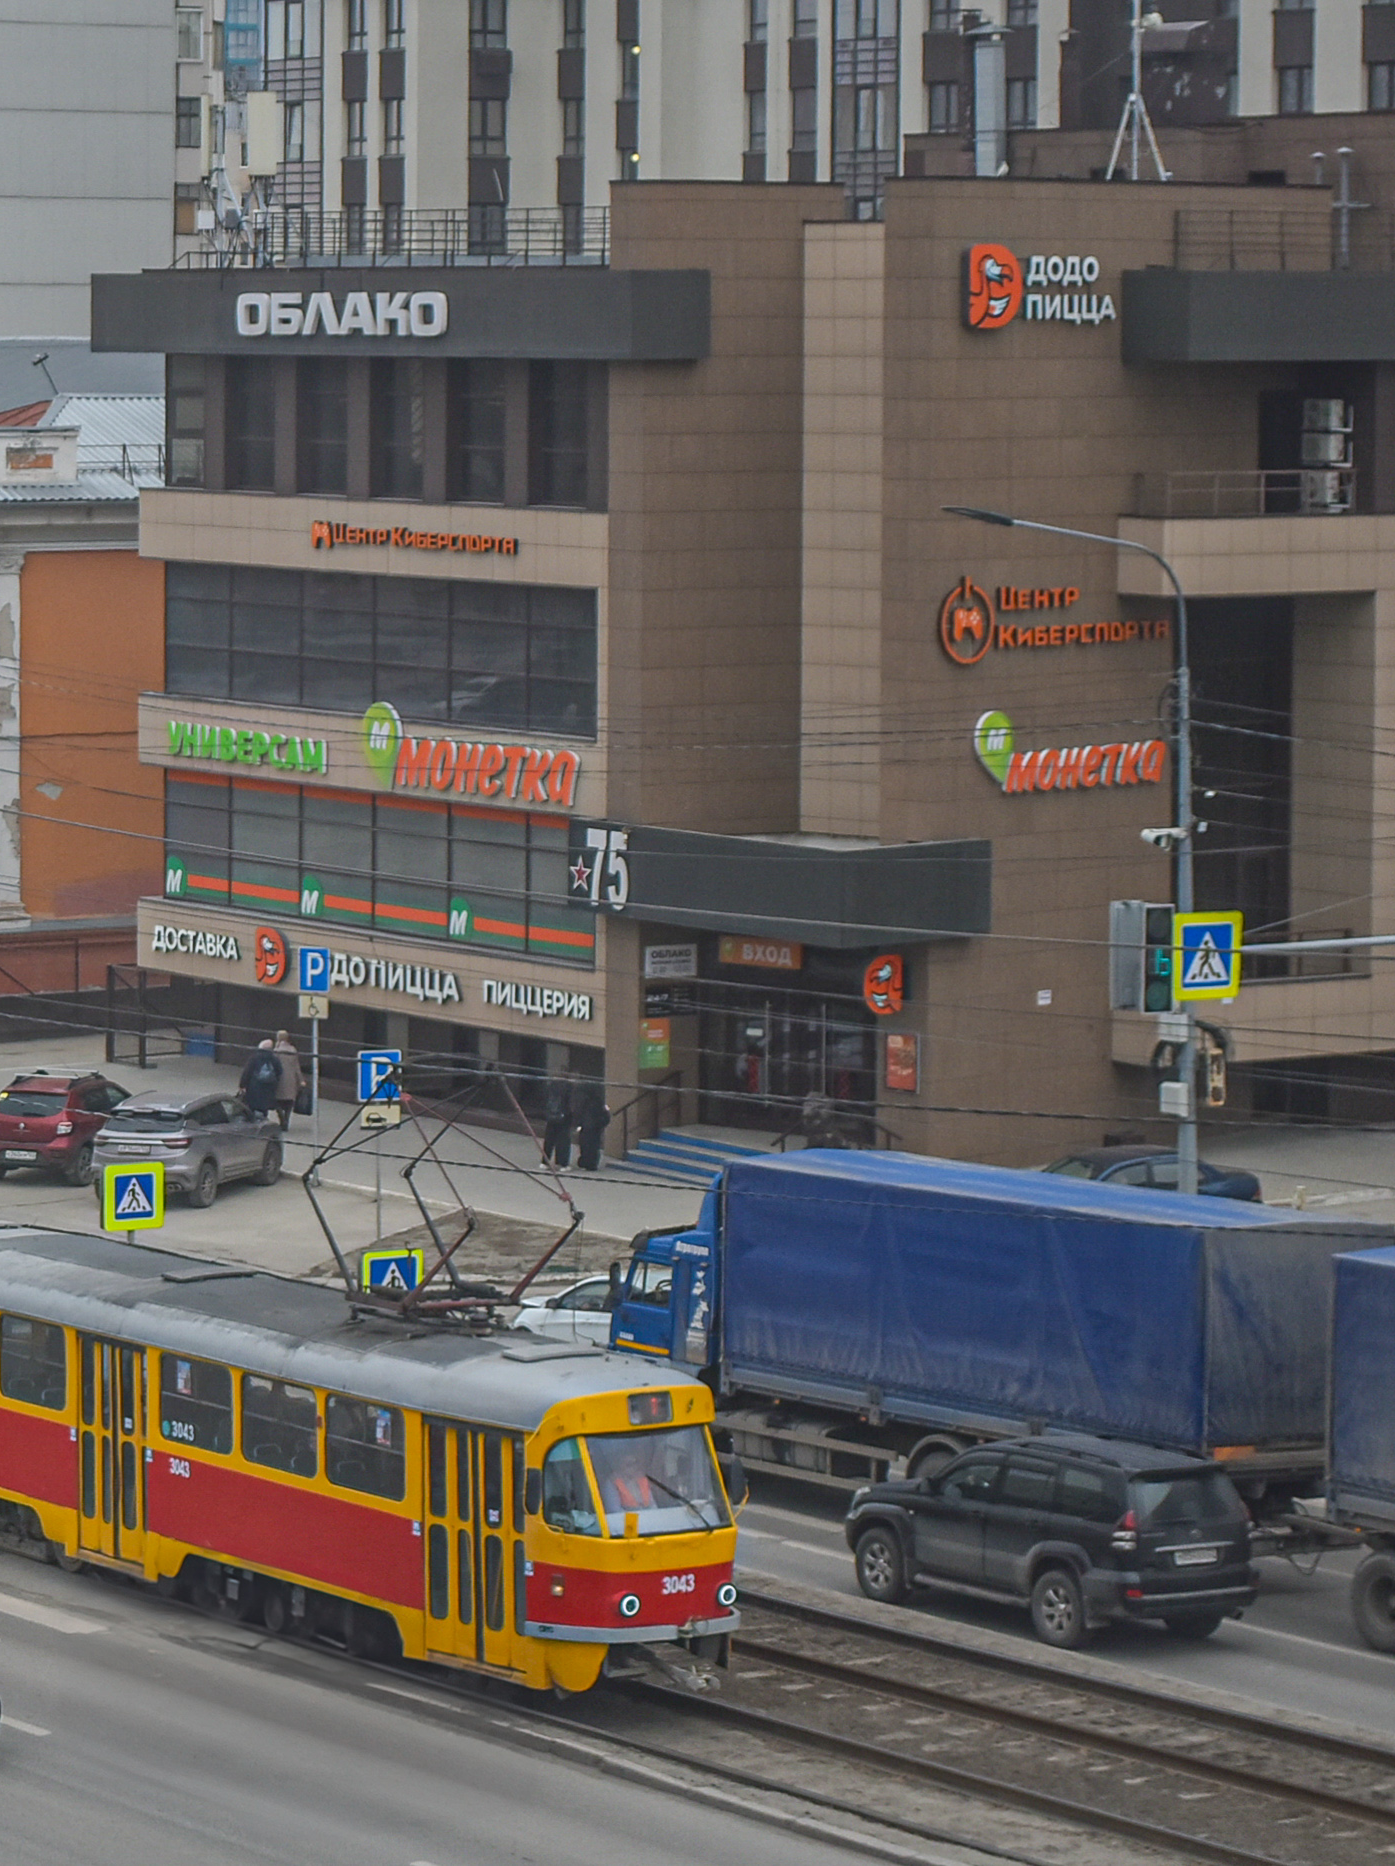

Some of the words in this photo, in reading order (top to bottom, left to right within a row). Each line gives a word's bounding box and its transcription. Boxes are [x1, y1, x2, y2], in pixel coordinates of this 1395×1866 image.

[1026, 254, 1100, 287] ДОДО
[236, 290, 449, 337] ОБЛАКО
[1025, 293, 1117, 326] ПИЦЦА
[167, 720, 328, 774] УНИВЕРСАМ
[585, 827, 629, 912] 75
[151, 925, 241, 961] ДОСТАВКА
[742, 943, 793, 966] ВХОД
[370, 958, 461, 1004] ПИЦЦА
[482, 979, 592, 1021] ПИЦЦЕРИЯ
[171, 1420, 195, 1441] 3043
[168, 1457, 191, 1478] 3043
[661, 1574, 696, 1595] 3043
